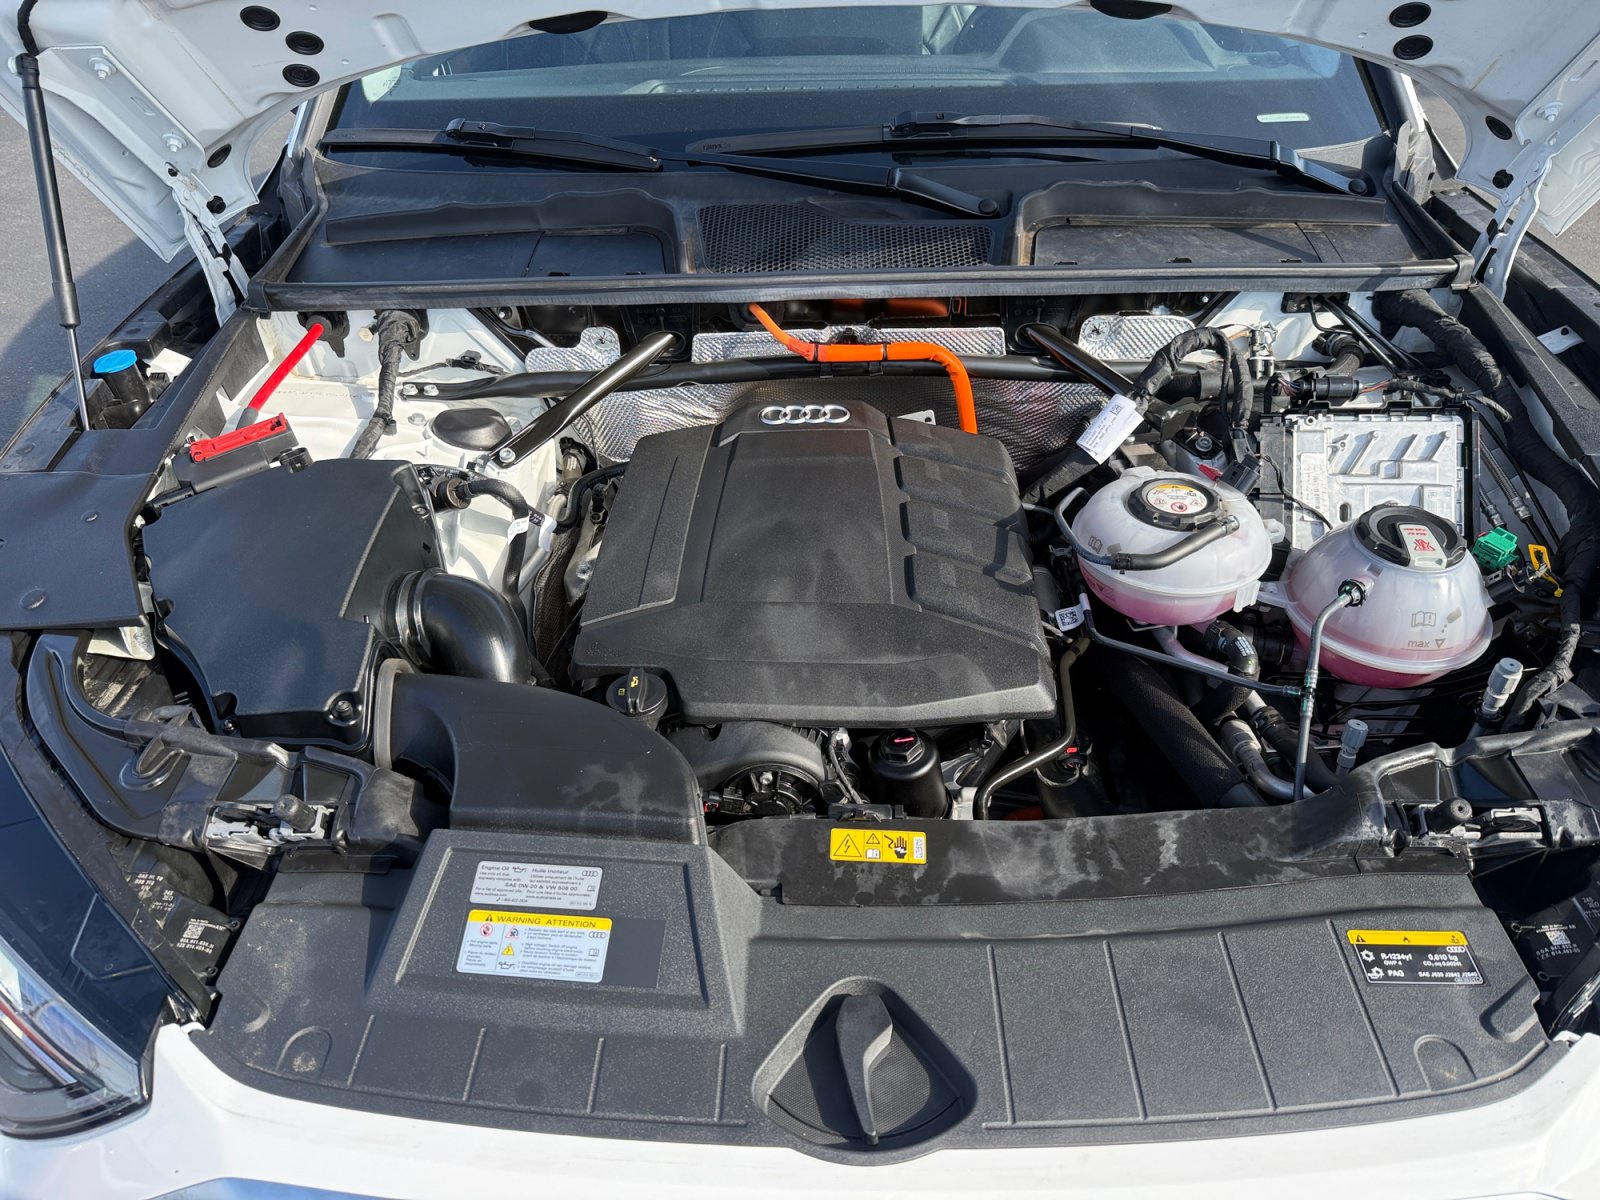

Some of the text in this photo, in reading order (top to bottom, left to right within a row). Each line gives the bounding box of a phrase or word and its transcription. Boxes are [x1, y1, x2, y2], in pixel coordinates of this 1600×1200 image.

[1407, 640, 1430, 648] max
[497, 915, 597, 928] WARNING ATTENTION
[1448, 953, 1459, 962] kg
[1387, 969, 1405, 977] PAG
